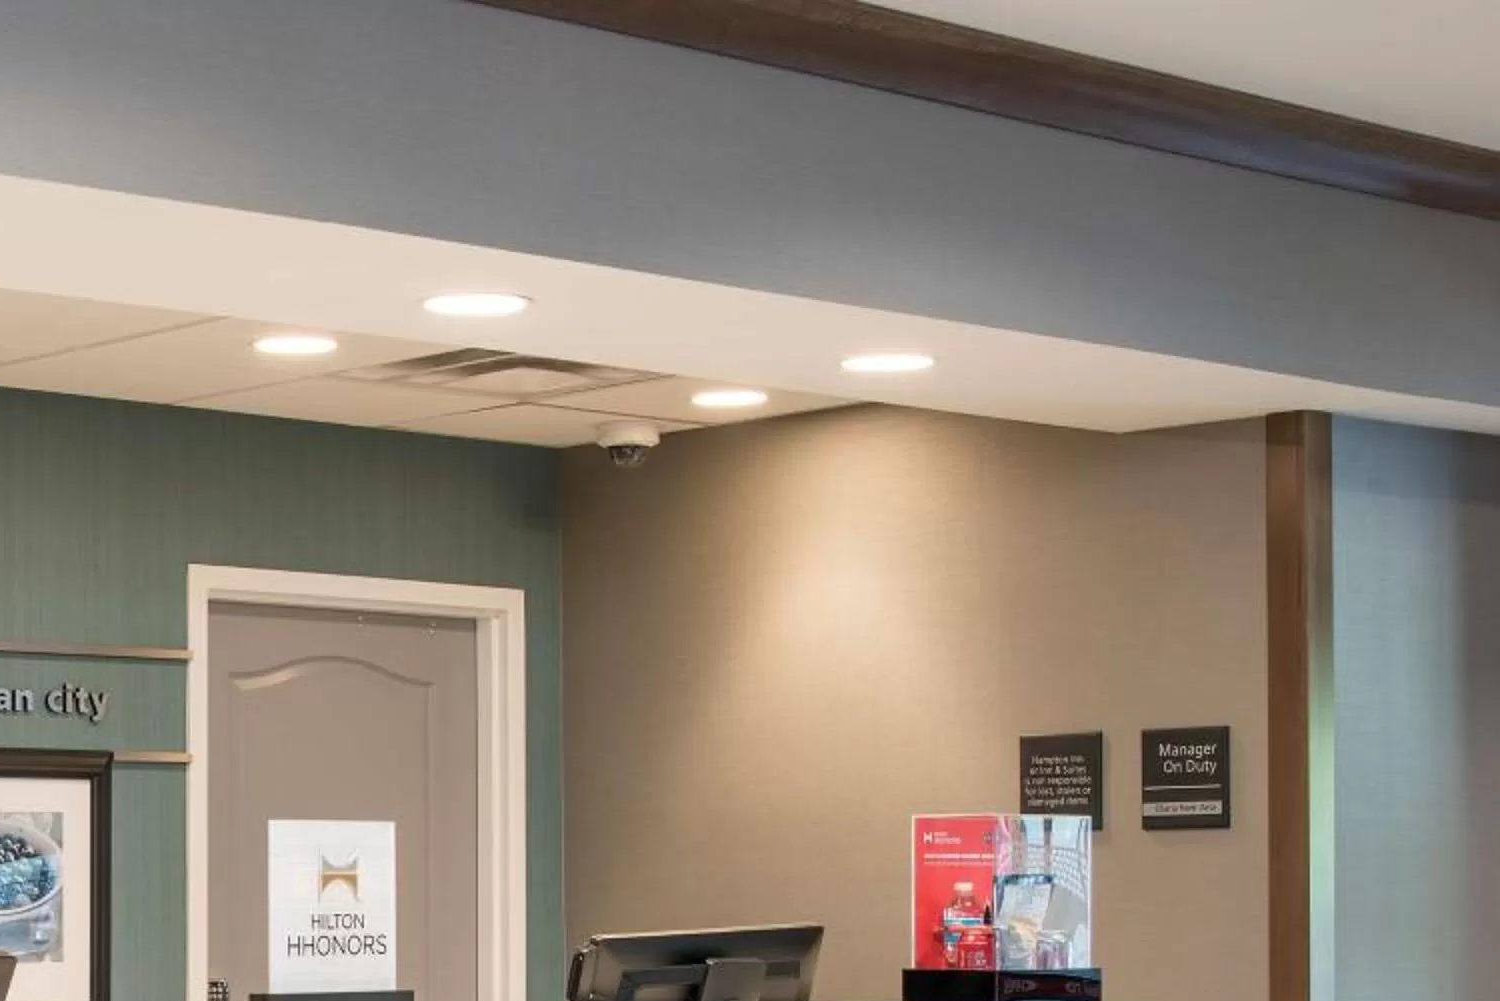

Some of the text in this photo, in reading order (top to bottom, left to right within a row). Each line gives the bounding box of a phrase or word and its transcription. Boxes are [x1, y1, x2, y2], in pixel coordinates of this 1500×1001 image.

[45, 683, 110, 723] city
[1158, 743, 1217, 759] Manager
[1163, 759, 1217, 776] On Duty
[311, 913, 365, 929] HILTON
[287, 934, 387, 957] HHONORS
